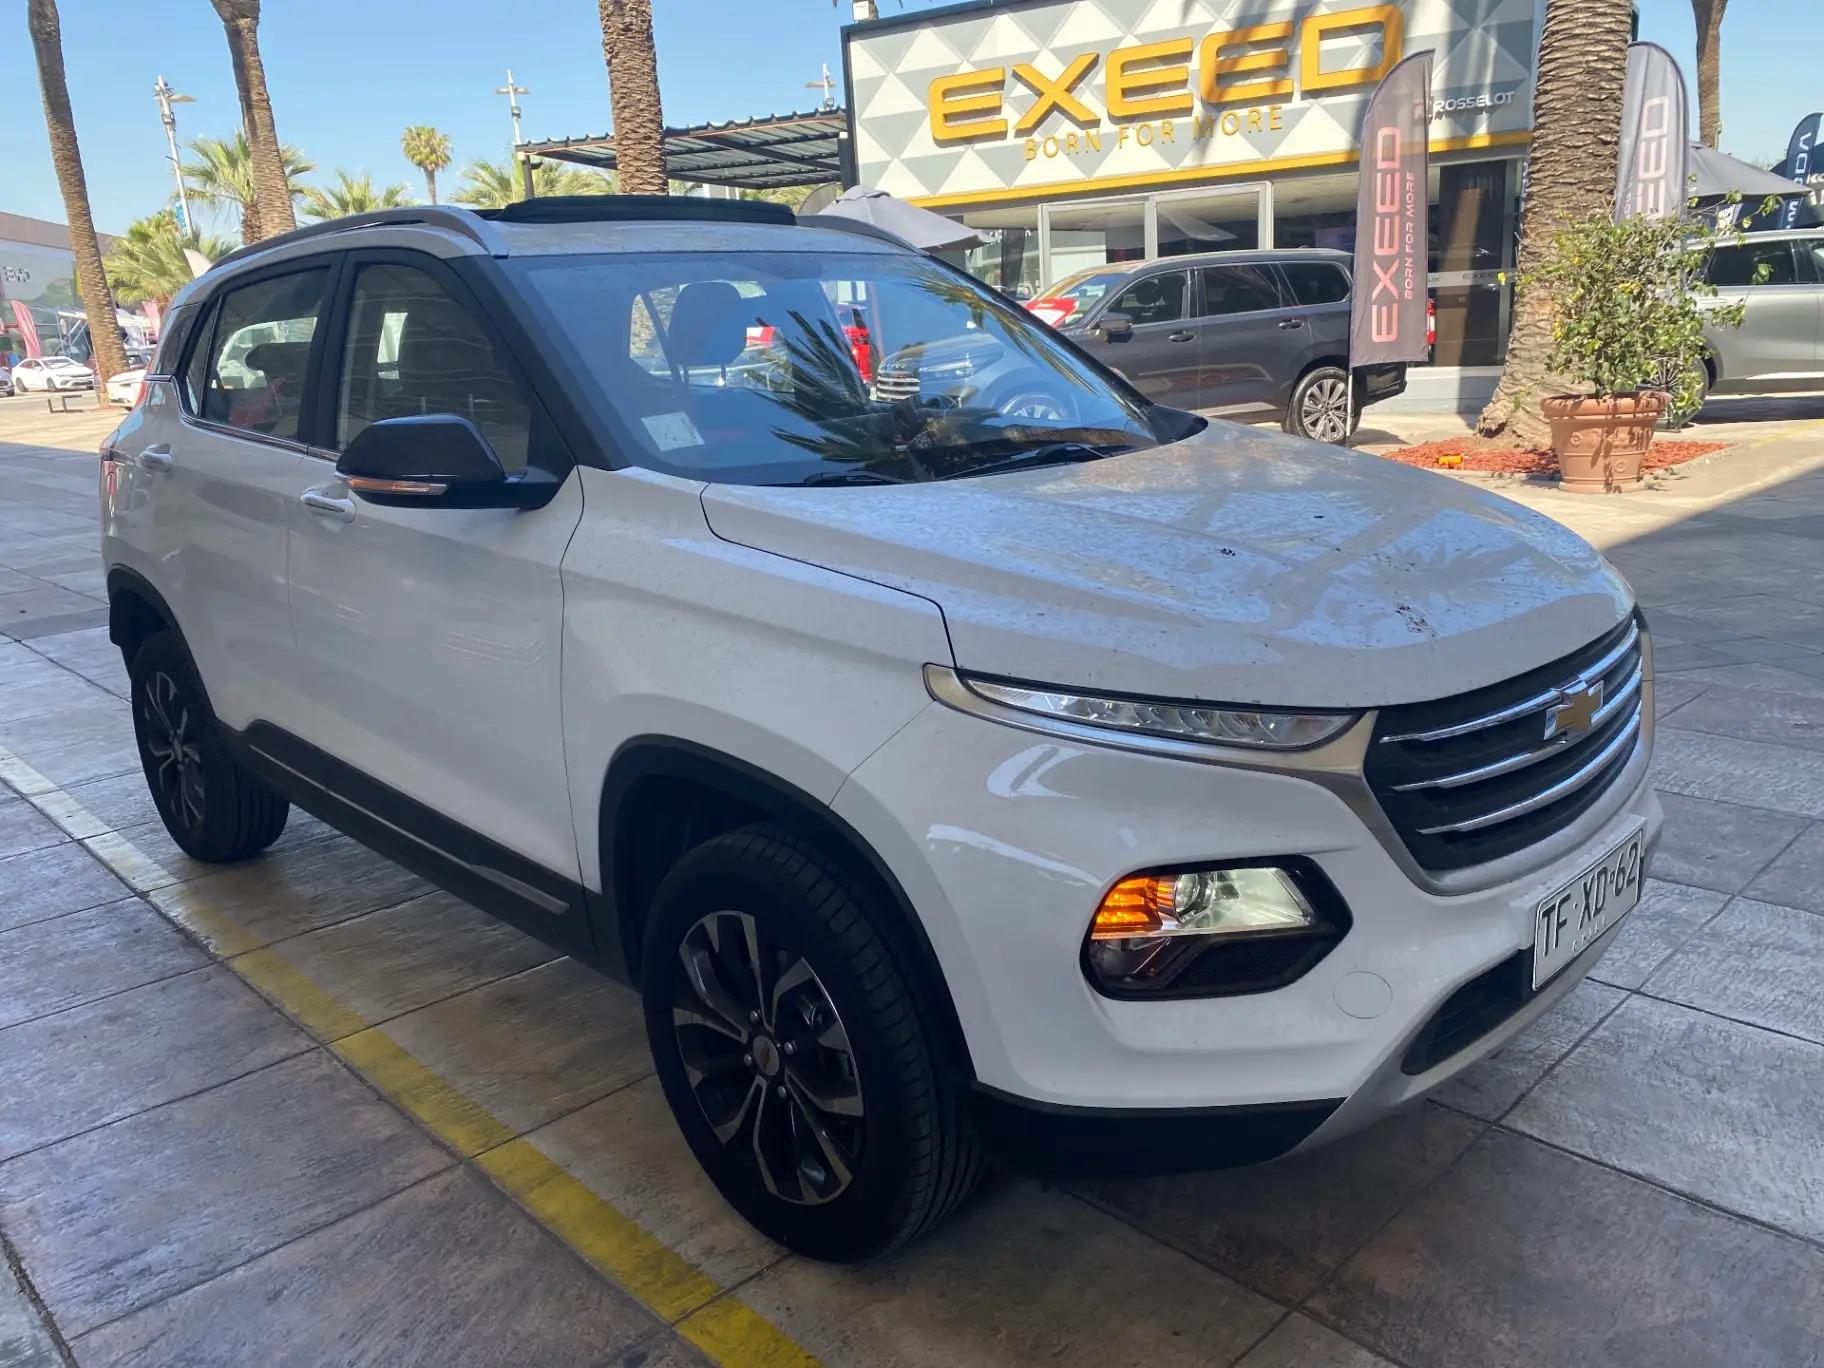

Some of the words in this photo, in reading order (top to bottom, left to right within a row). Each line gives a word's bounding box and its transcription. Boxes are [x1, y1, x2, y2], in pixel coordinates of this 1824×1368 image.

[928, 4, 1402, 142] EXEED
[1434, 90, 1515, 112] ROSSELOT
[1023, 135, 1100, 160] BORN
[1118, 119, 1174, 149] FOR
[1193, 106, 1283, 141] MORE
[1406, 171, 1415, 217] MORE
[1371, 126, 1400, 343] EXEED
[1405, 222, 1414, 253] FOR
[1404, 257, 1414, 300] BORN
